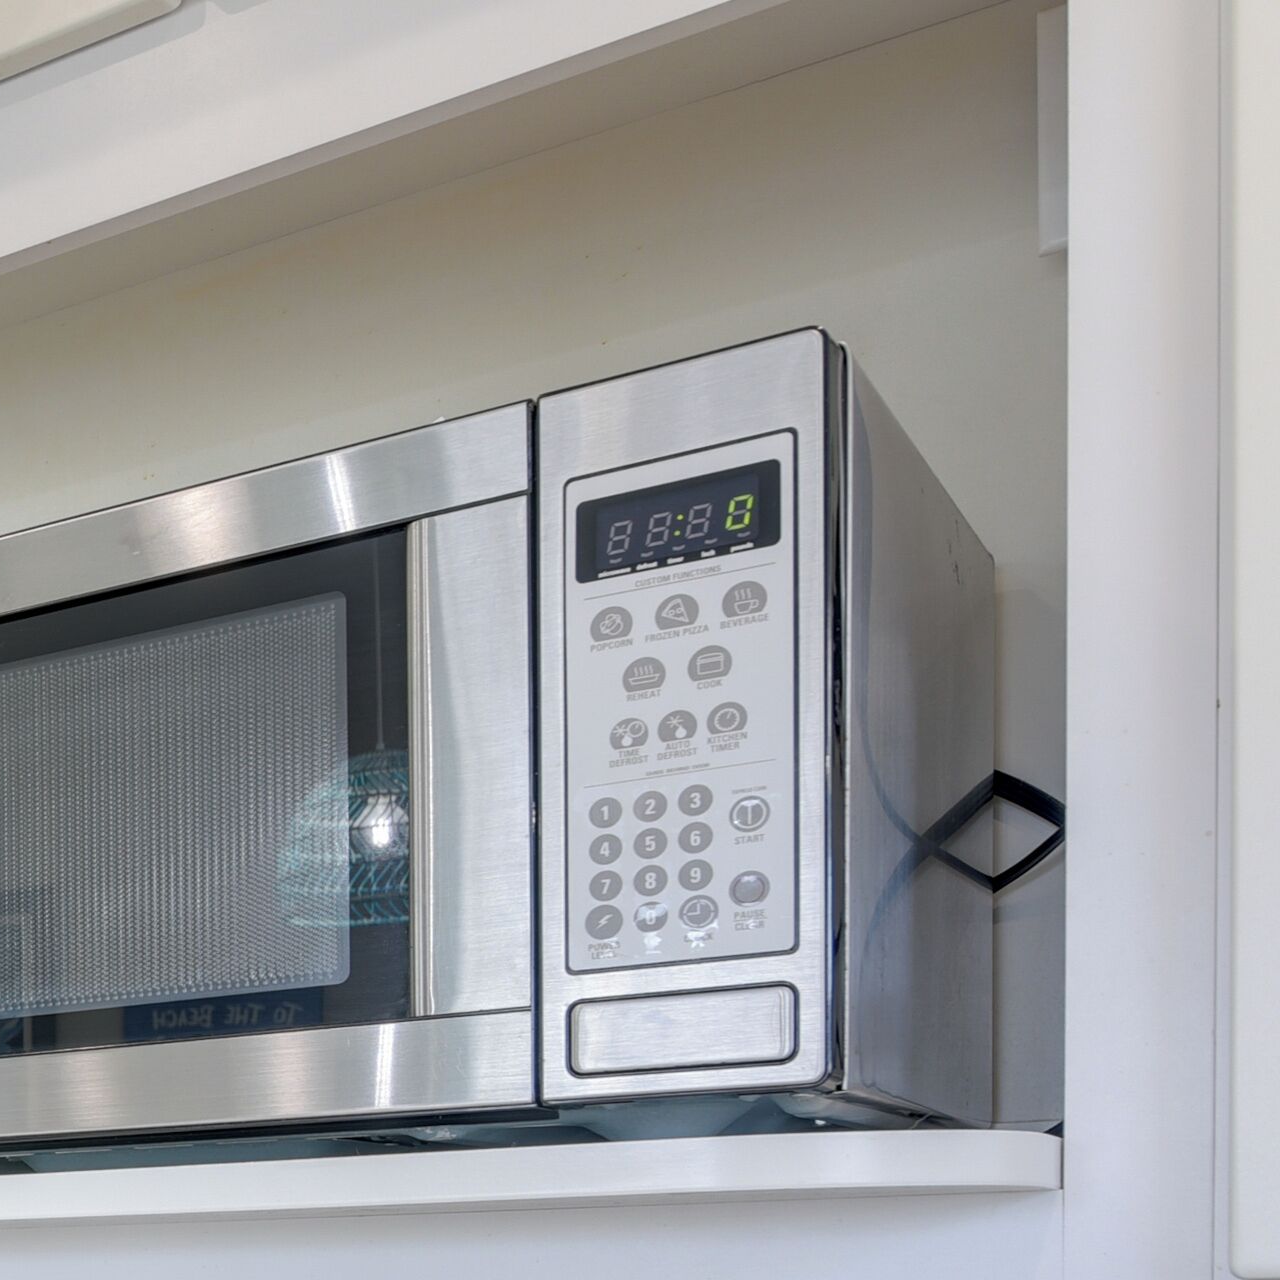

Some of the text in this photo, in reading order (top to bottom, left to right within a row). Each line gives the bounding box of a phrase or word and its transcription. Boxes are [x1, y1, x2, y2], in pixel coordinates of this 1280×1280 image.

[634, 573, 671, 588] CUSTOM
[672, 565, 722, 581] FUNCTIONS
[720, 613, 770, 630] BEVERAGE
[644, 624, 710, 642] FROZEN PIZZA
[590, 638, 634, 652] POPCORN
[696, 679, 723, 690] COOK
[626, 689, 662, 702] REHEAT
[707, 732, 748, 744] KITCHEN
[665, 741, 690, 751] AUTO
[710, 742, 740, 753] TIMER
[618, 748, 640, 758] TIME
[657, 748, 698, 761] DEFROST
[608, 755, 649, 768] DEFROST
[600, 792, 701, 821] 1 2 3
[600, 830, 701, 857] 4 5 6
[734, 834, 765, 845] START
[601, 867, 701, 894] 7 8 9
[646, 909, 656, 925] 0
[734, 909, 766, 920] PAUSE
[735, 920, 765, 931] CLR
